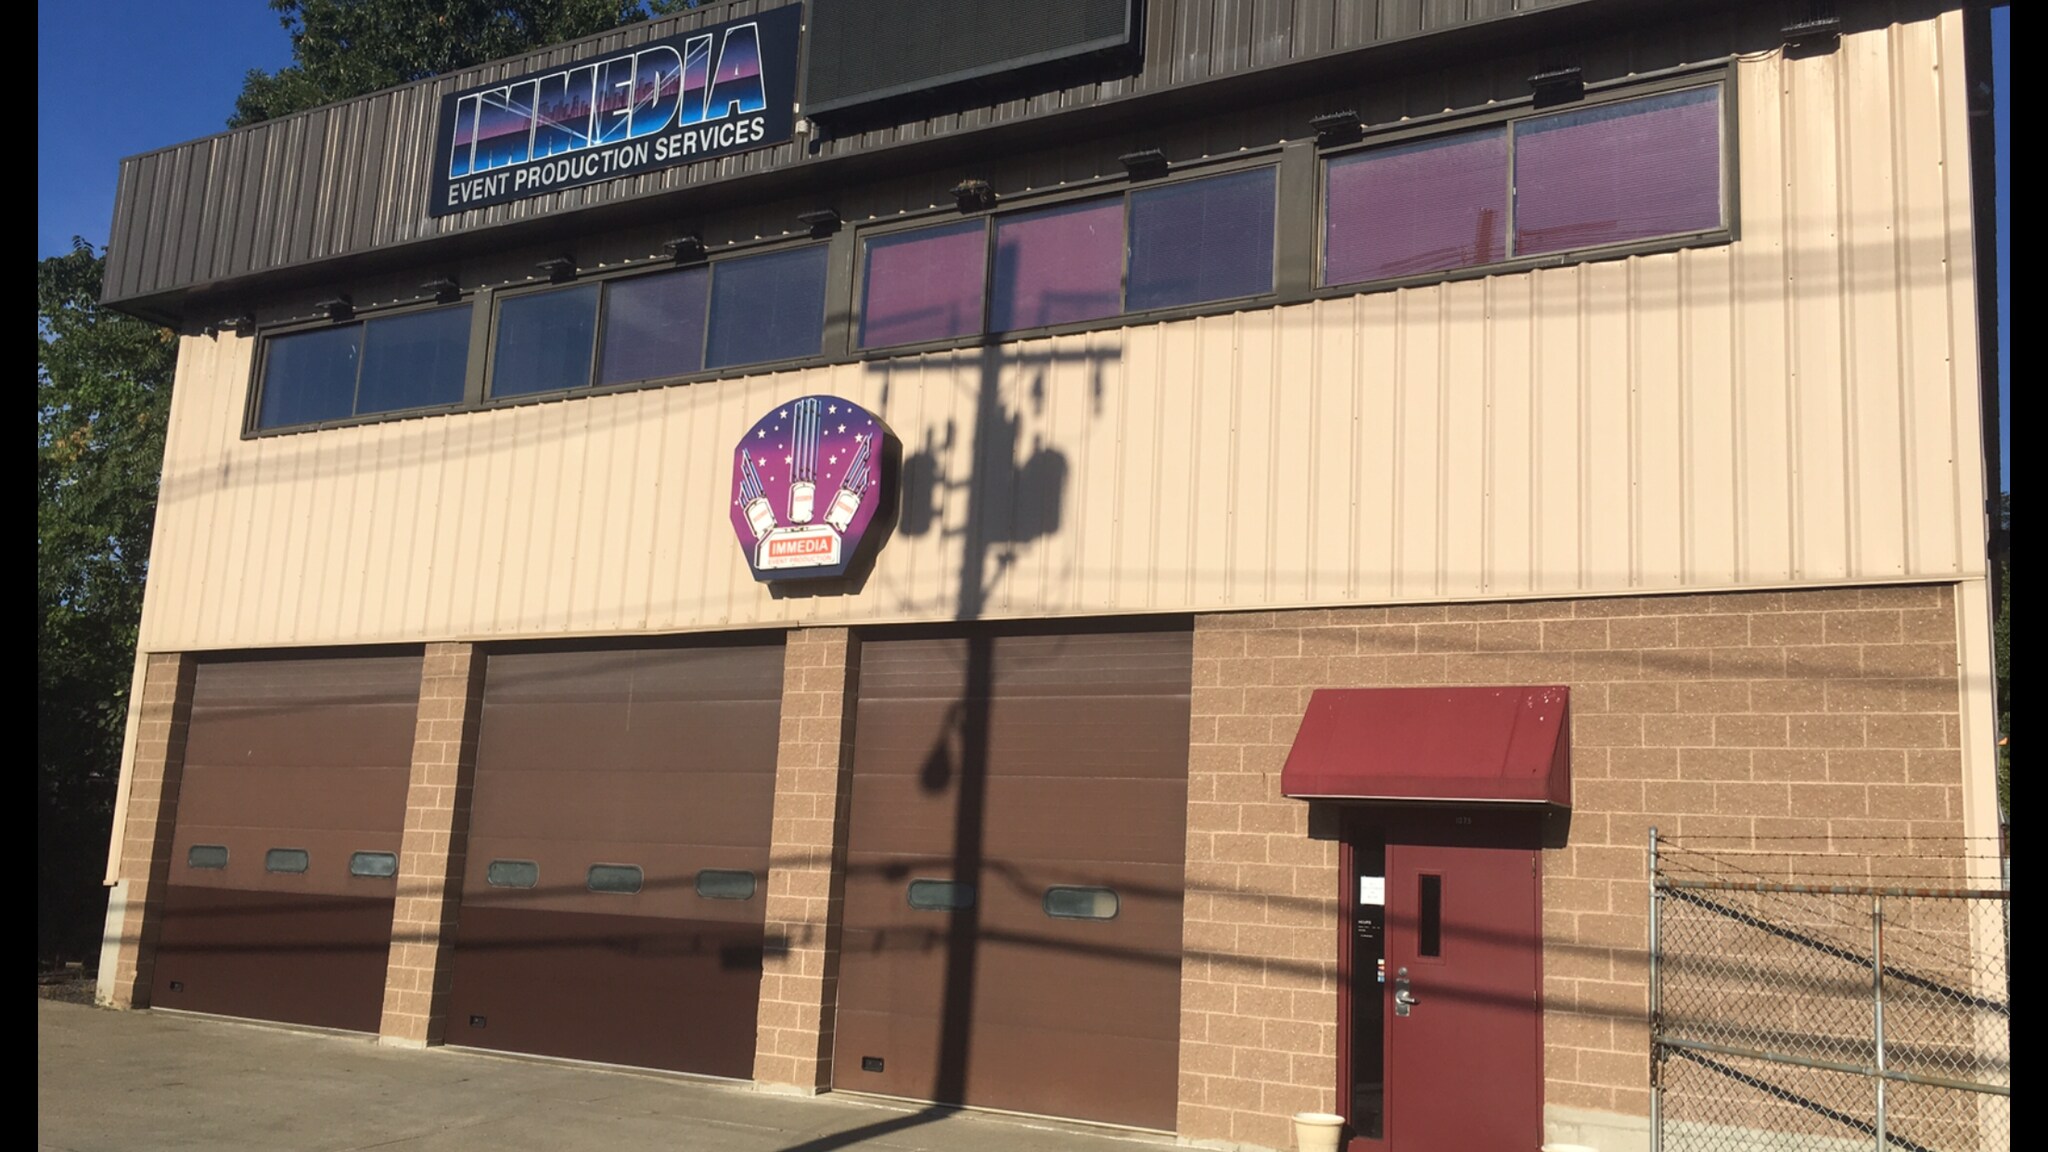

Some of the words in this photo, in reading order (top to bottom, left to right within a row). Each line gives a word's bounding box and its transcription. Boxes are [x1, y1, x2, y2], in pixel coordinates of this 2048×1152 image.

[449, 22, 767, 180] IMMEDIA
[448, 174, 507, 206] EVENT
[514, 141, 649, 192] PRODUCTION
[655, 117, 765, 162] SERVICES
[772, 538, 829, 555] IMMEDIA
